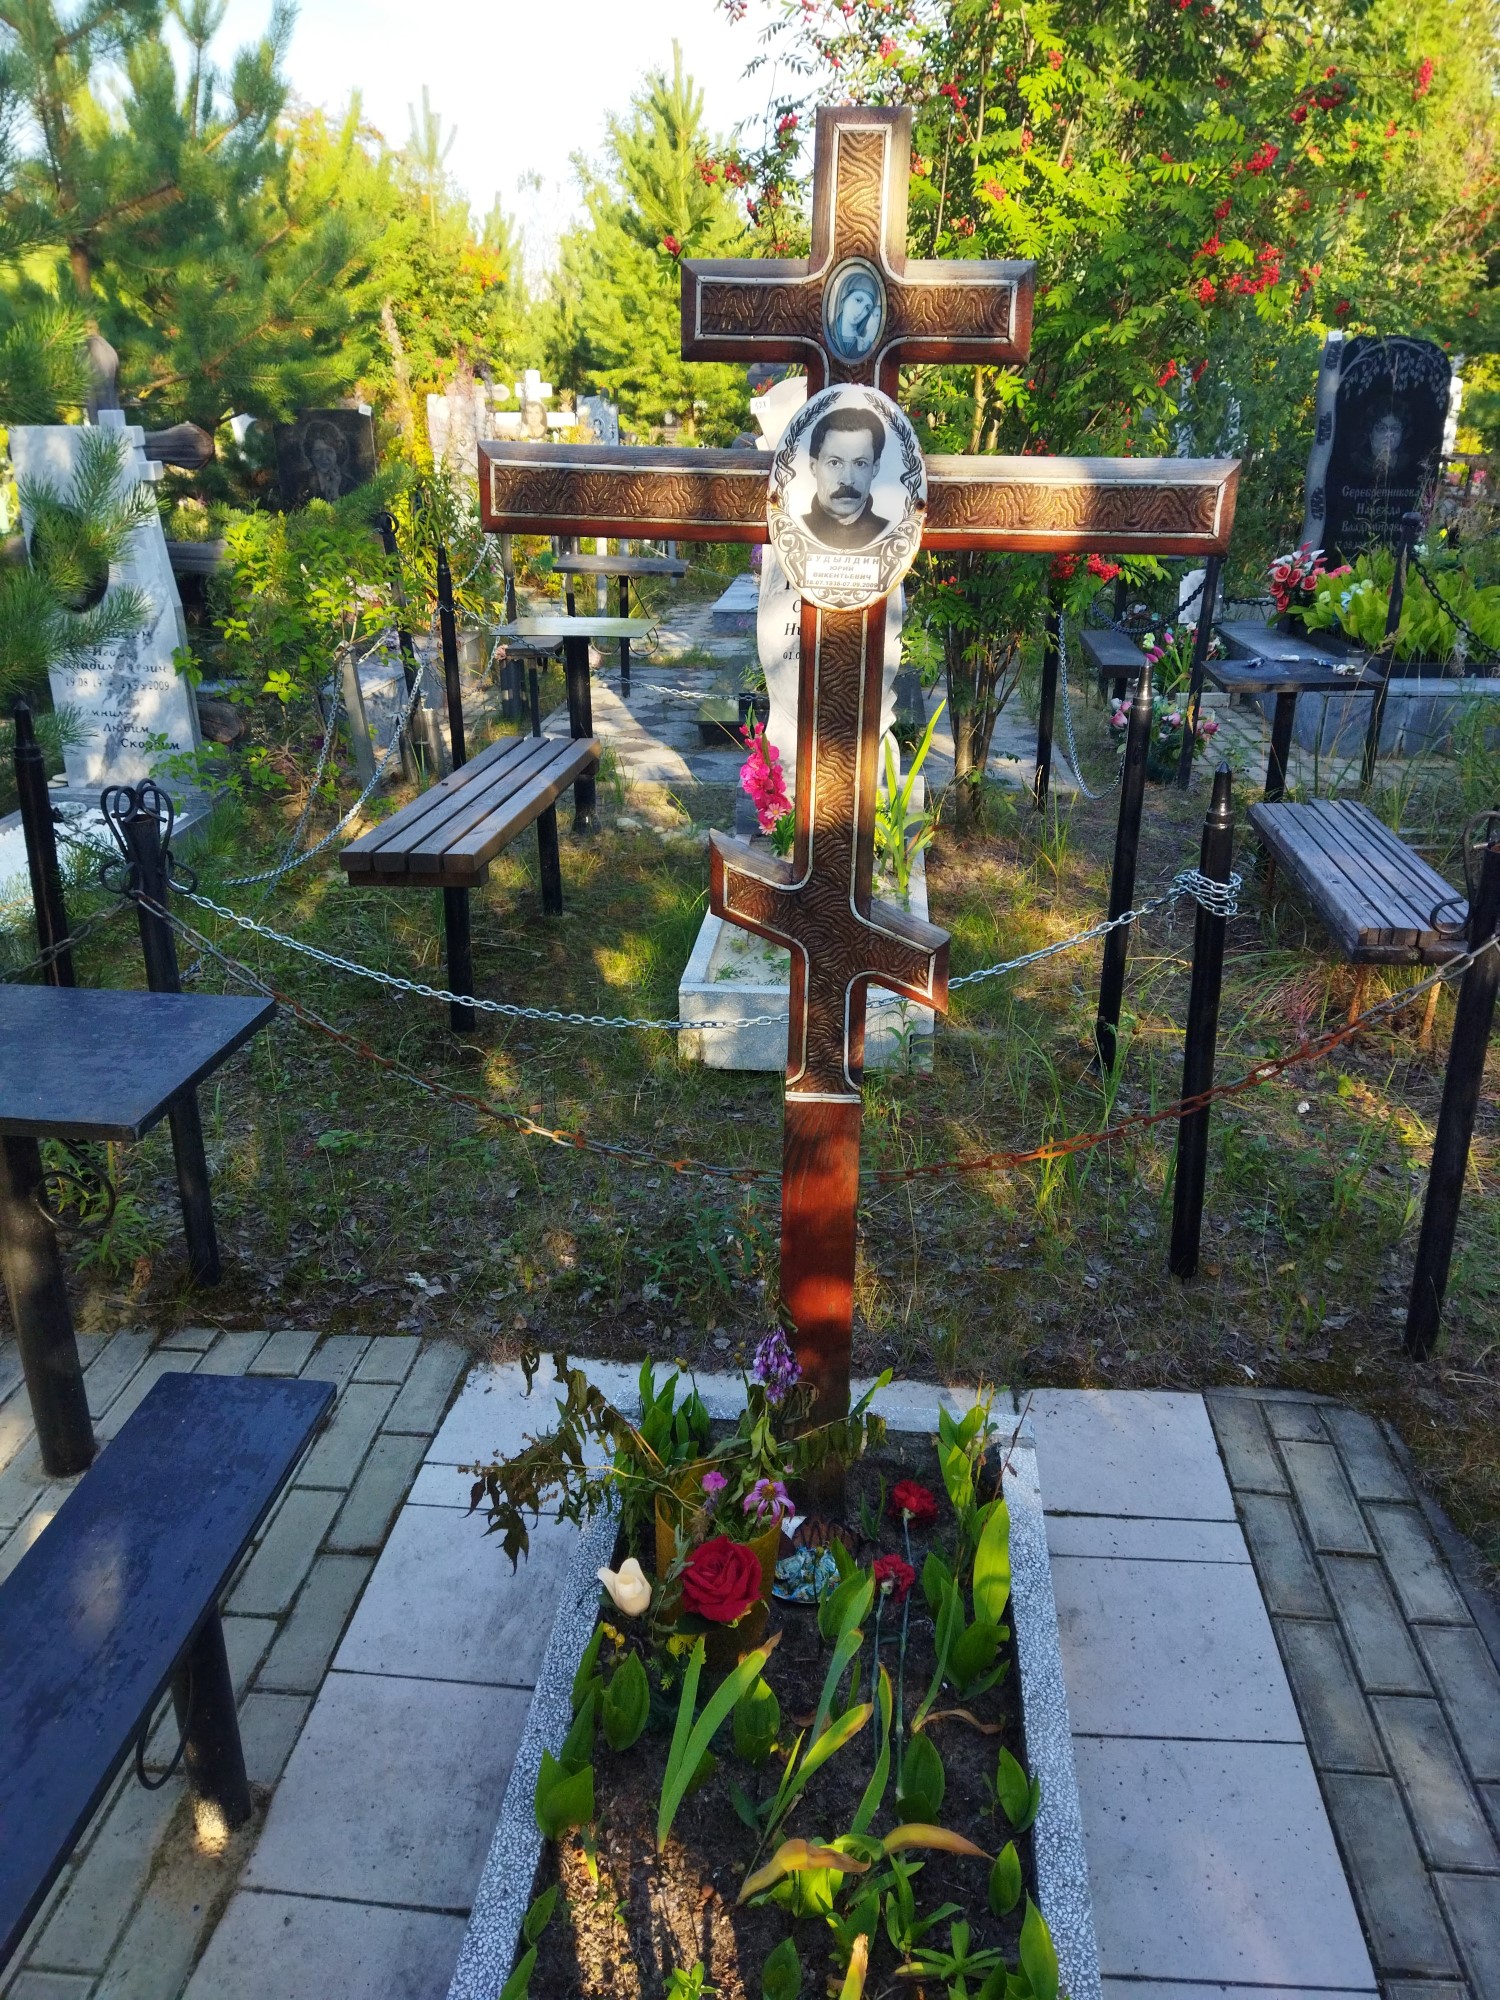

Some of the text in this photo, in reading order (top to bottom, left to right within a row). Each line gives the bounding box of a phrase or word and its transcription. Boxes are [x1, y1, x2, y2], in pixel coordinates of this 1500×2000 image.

[806, 555, 880, 565] БУДЫЛДИН
[829, 565, 855, 573] ЮРИЙ
[812, 571, 872, 580] ВИКЕНТЬЕВИЧ
